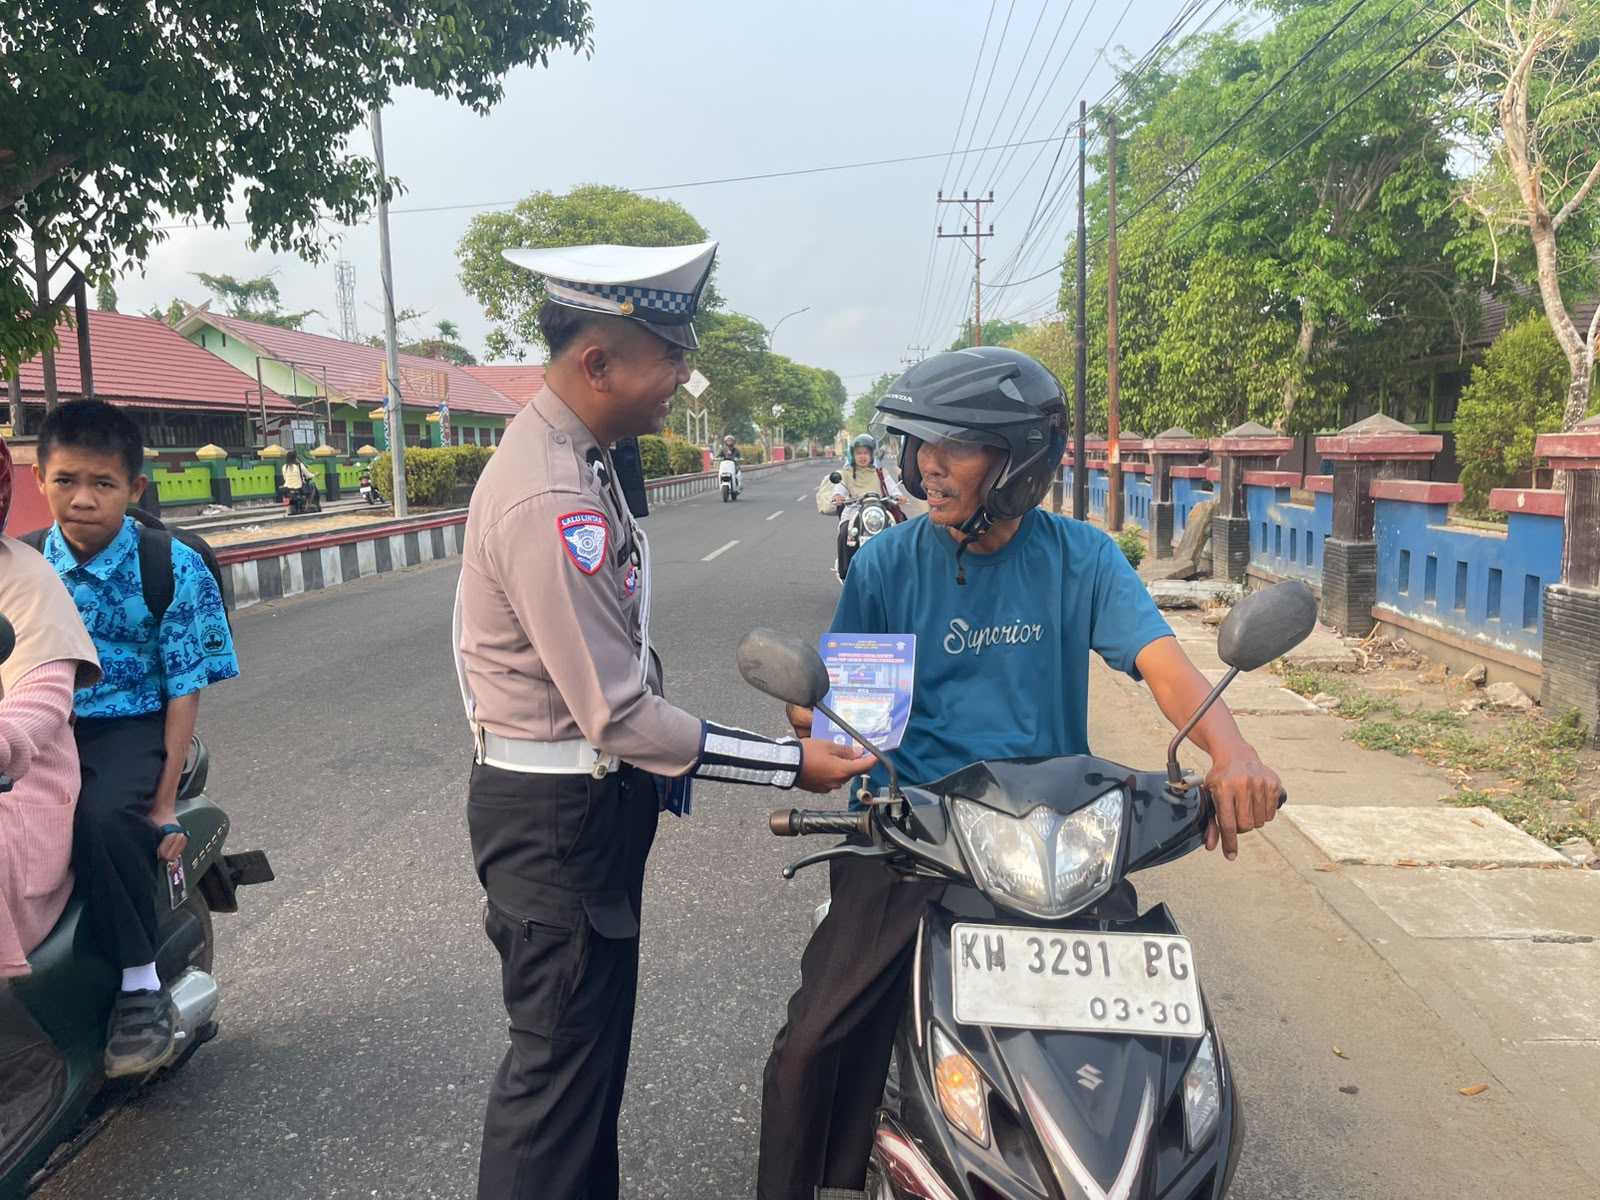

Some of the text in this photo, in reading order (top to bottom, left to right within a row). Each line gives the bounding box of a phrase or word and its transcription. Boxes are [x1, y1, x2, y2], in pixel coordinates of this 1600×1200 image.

[943, 618, 1044, 655] Superior
[960, 932, 1189, 980] KH 3291 PG
